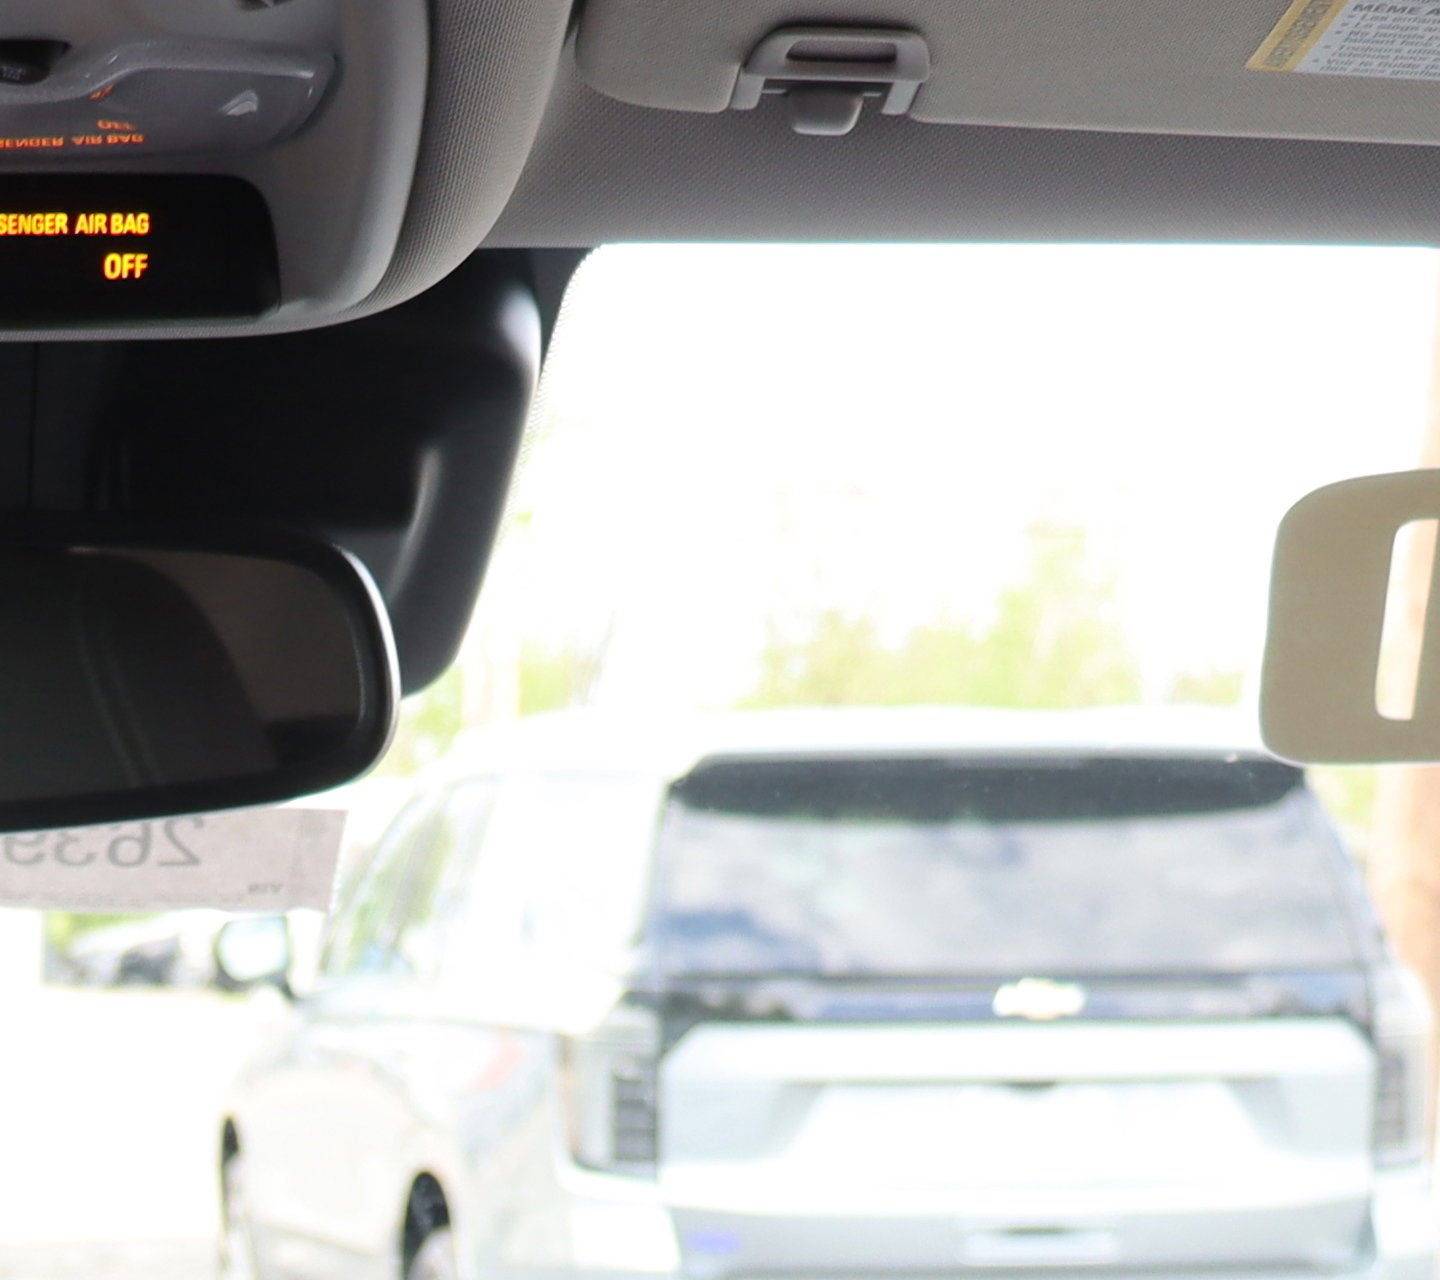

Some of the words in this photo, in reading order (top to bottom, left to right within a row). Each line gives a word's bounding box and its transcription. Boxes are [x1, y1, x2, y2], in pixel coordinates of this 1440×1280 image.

[74, 212, 107, 235] AIR
[110, 212, 151, 236] BAG
[103, 252, 149, 280] OFF
